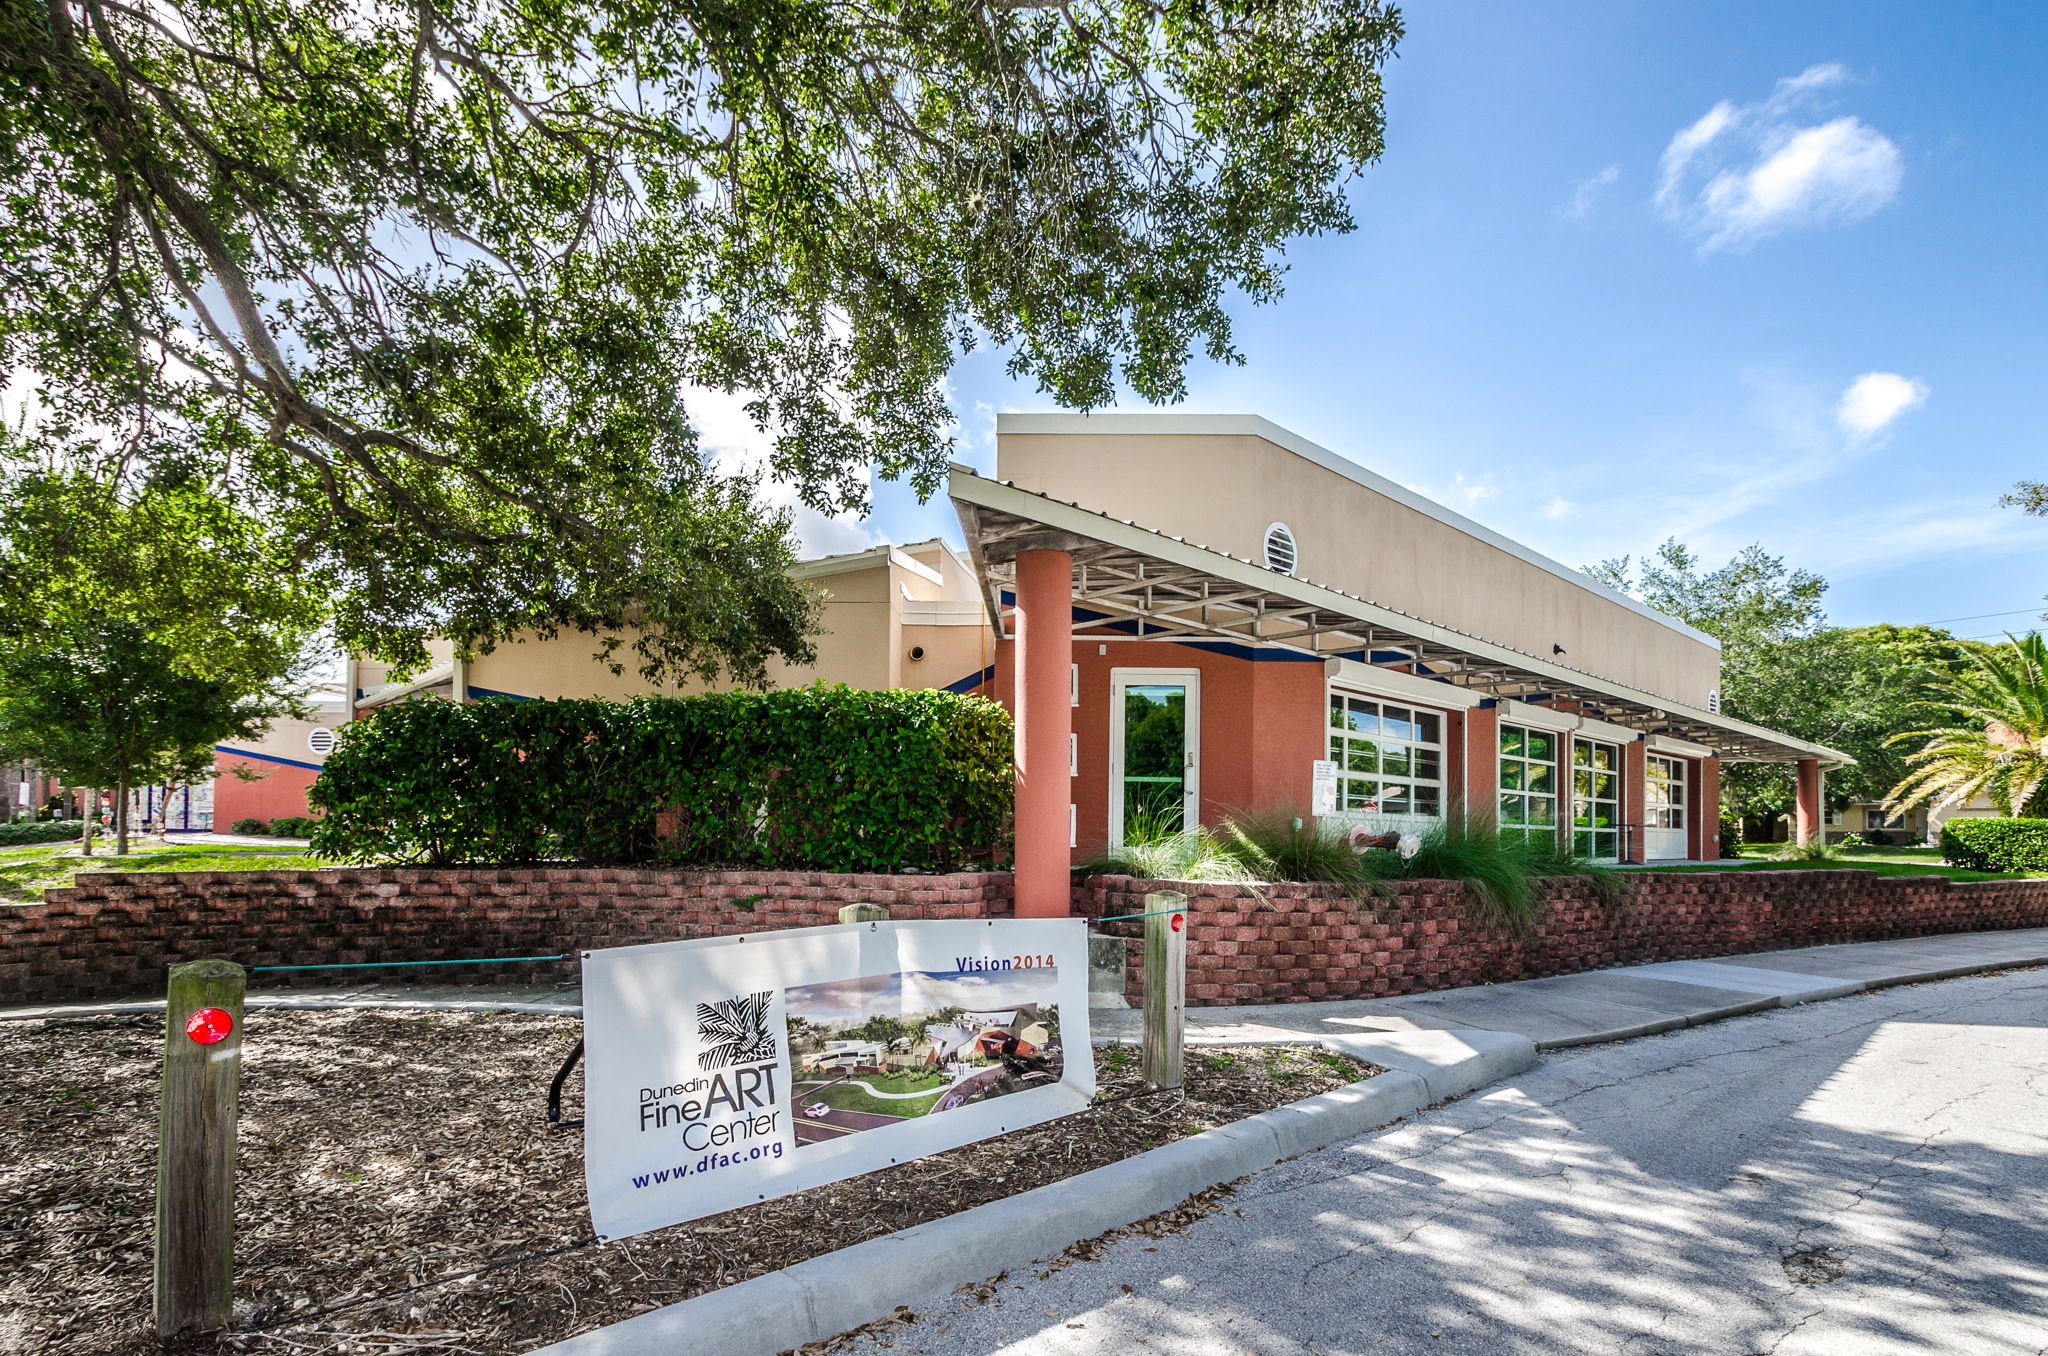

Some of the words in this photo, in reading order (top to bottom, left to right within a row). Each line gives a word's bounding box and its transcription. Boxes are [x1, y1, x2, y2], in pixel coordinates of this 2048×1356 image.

[640, 1077, 709, 1103] Dunedin
[682, 1110, 781, 1152] Center
[632, 1141, 783, 1189] www.dfac.org
